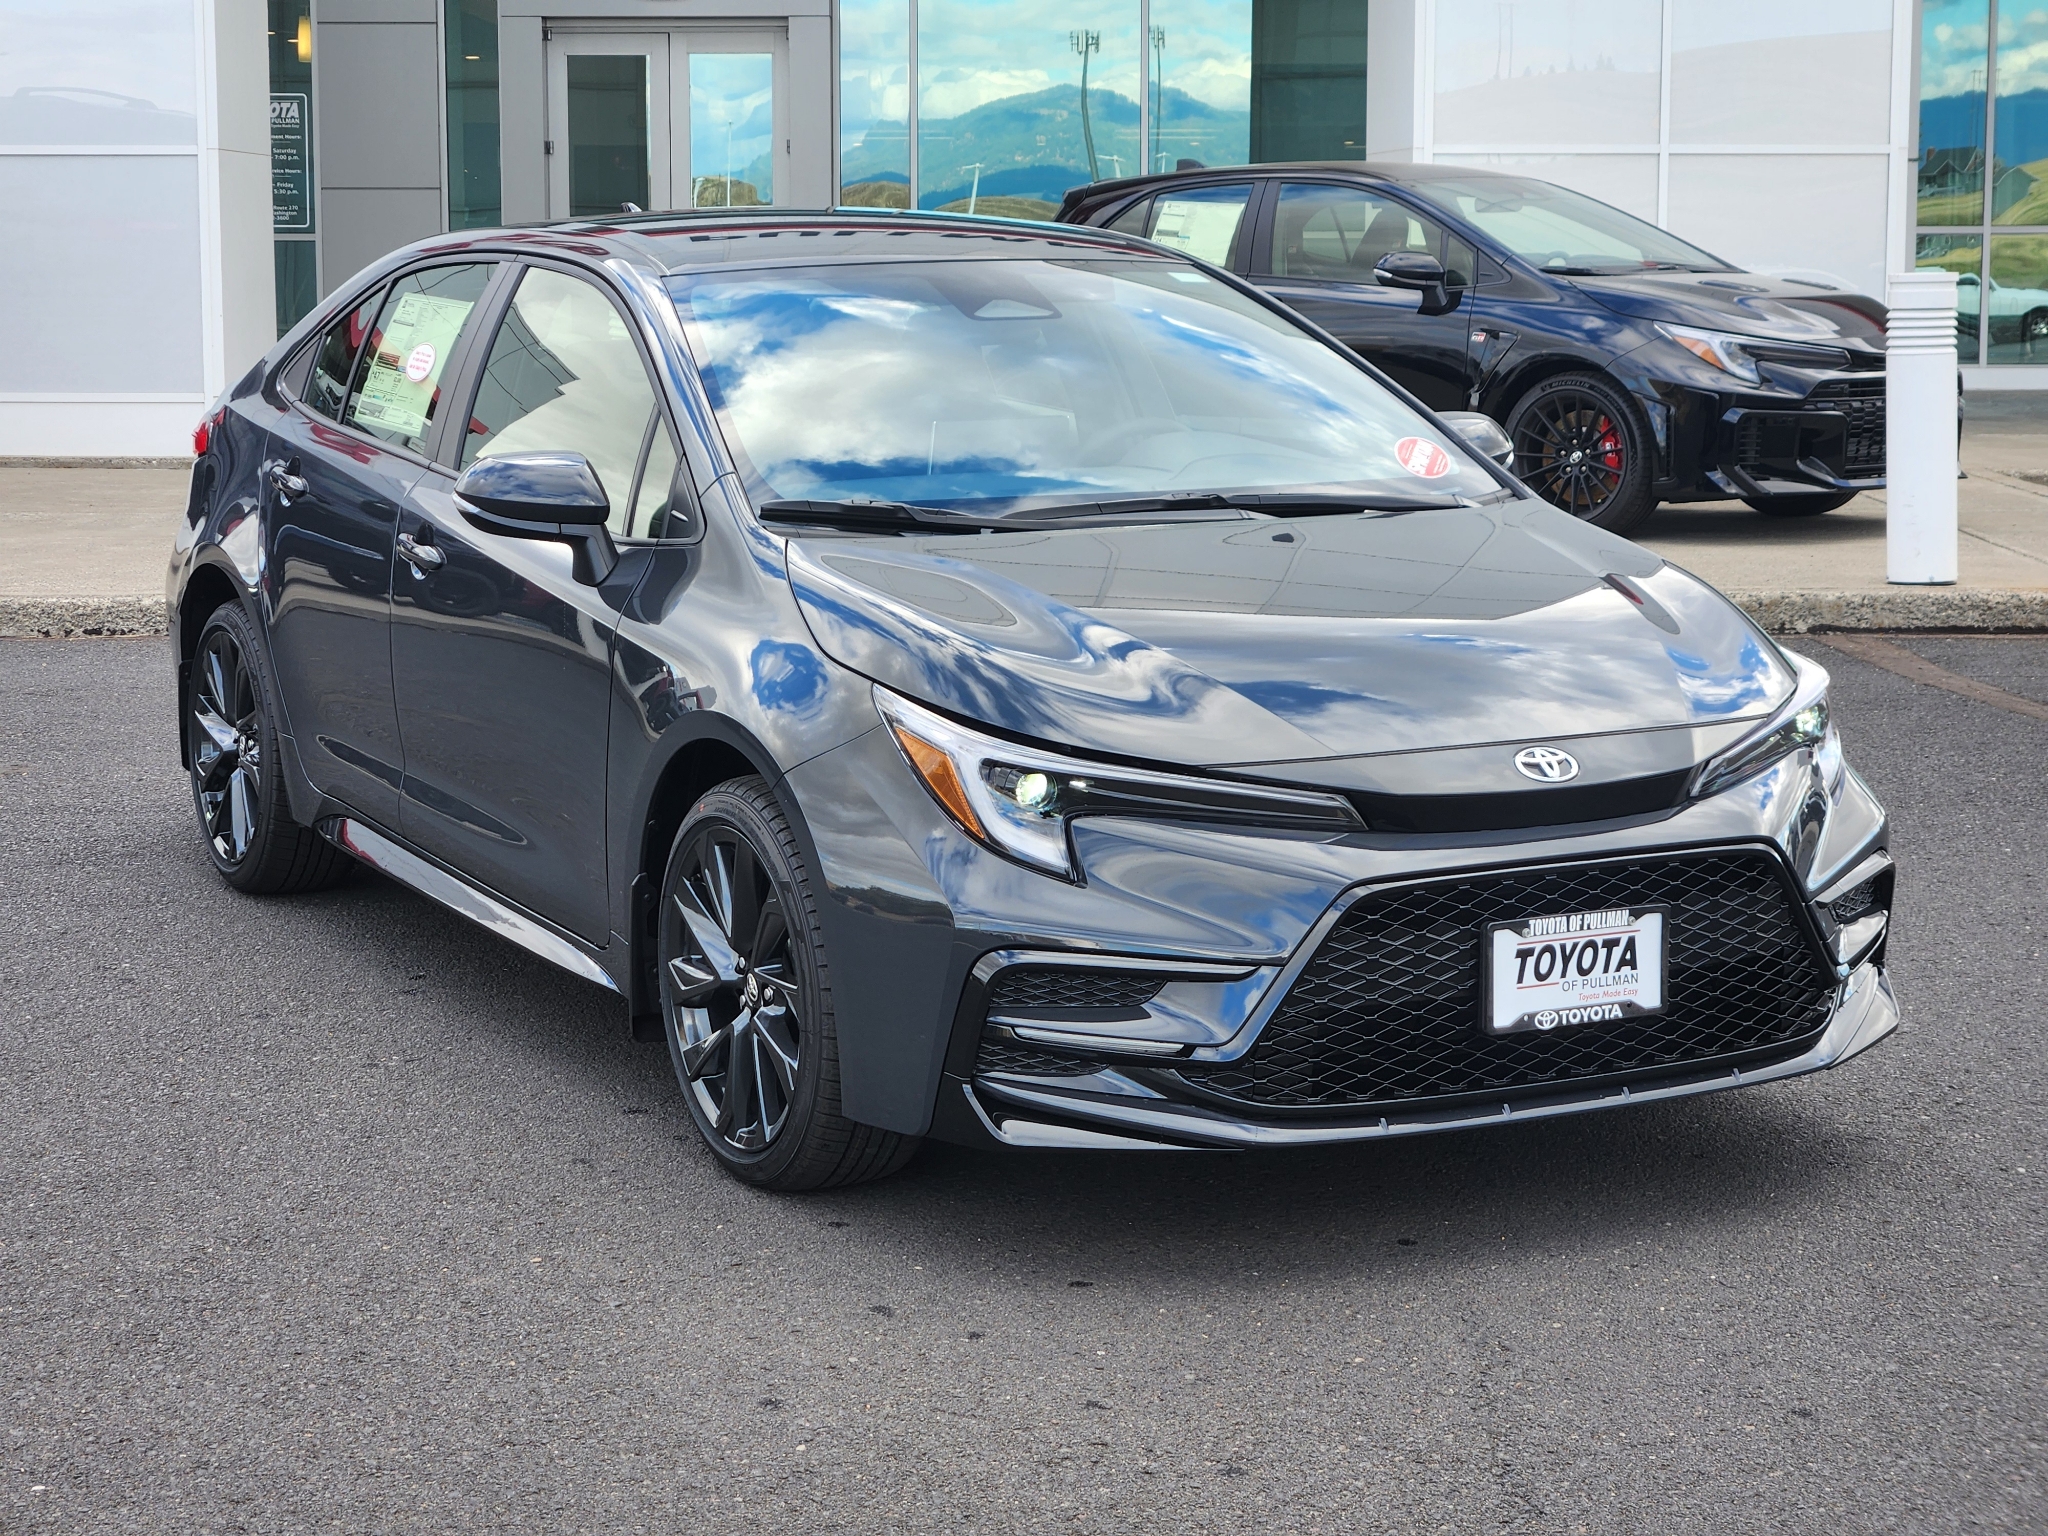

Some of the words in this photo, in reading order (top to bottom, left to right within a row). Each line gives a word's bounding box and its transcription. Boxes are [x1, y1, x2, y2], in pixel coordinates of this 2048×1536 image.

[1551, 380, 1591, 389] MICHELIN
[1528, 917, 1568, 938] TOYOTA
[1569, 914, 1582, 931] OF
[1583, 909, 1630, 931] PULLMAN
[1514, 935, 1638, 985] TOYOTA
[1562, 980, 1578, 992] OF
[1582, 973, 1639, 990] PULLMAN
[1578, 992, 1600, 1003] Toyota
[1602, 989, 1621, 999] Made
[1623, 988, 1639, 997] Easy
[1560, 1003, 1624, 1026] TOYOTA
